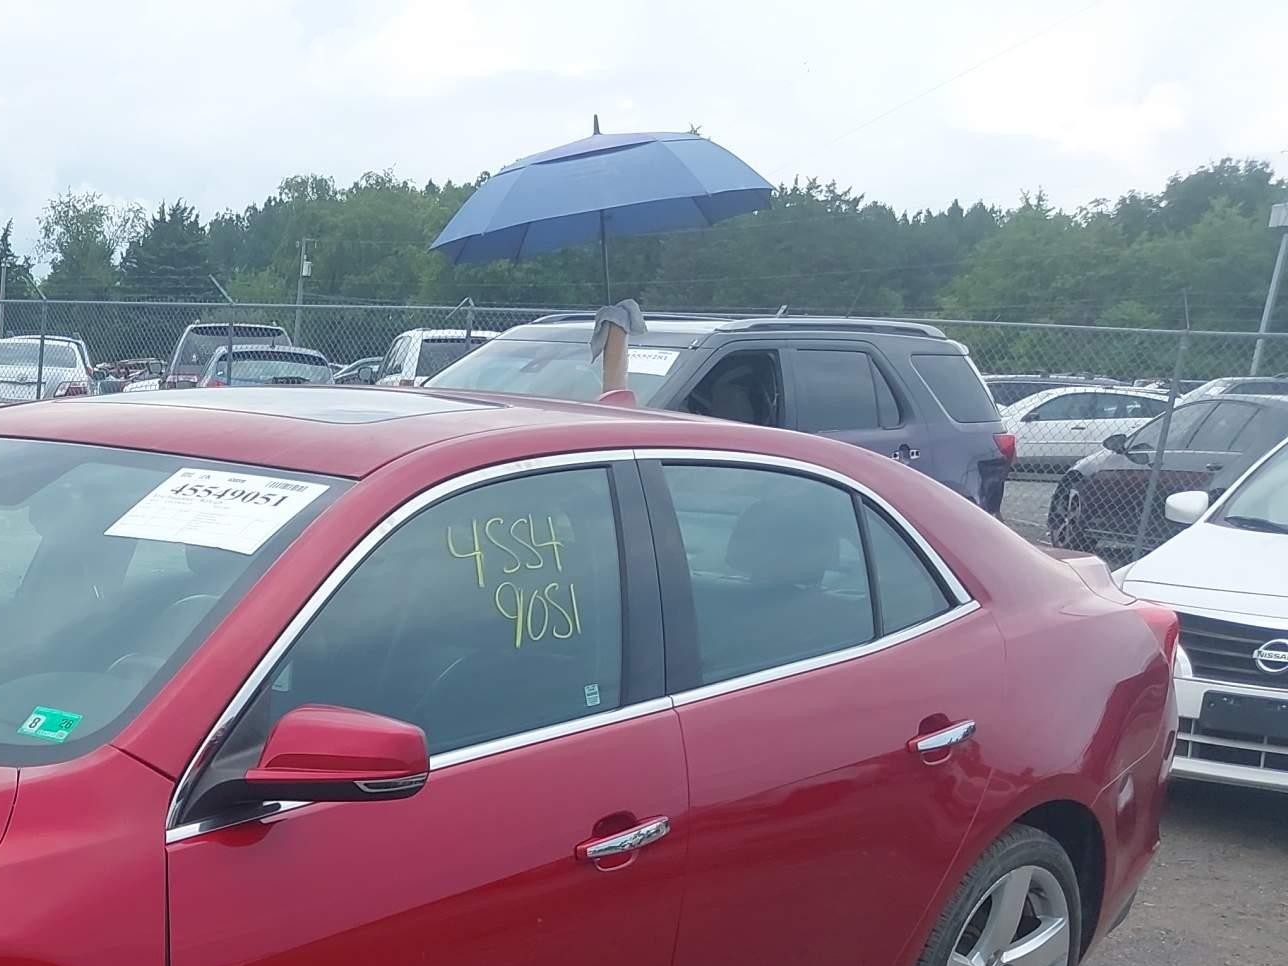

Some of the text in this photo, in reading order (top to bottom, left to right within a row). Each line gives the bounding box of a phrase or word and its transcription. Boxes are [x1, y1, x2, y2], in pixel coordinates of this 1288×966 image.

[170, 483, 289, 507] 45549051
[446, 513, 565, 588] 4554
[494, 581, 583, 649] 9051
[1257, 650, 1288, 660] NISSA
[28, 717, 41, 729] 8
